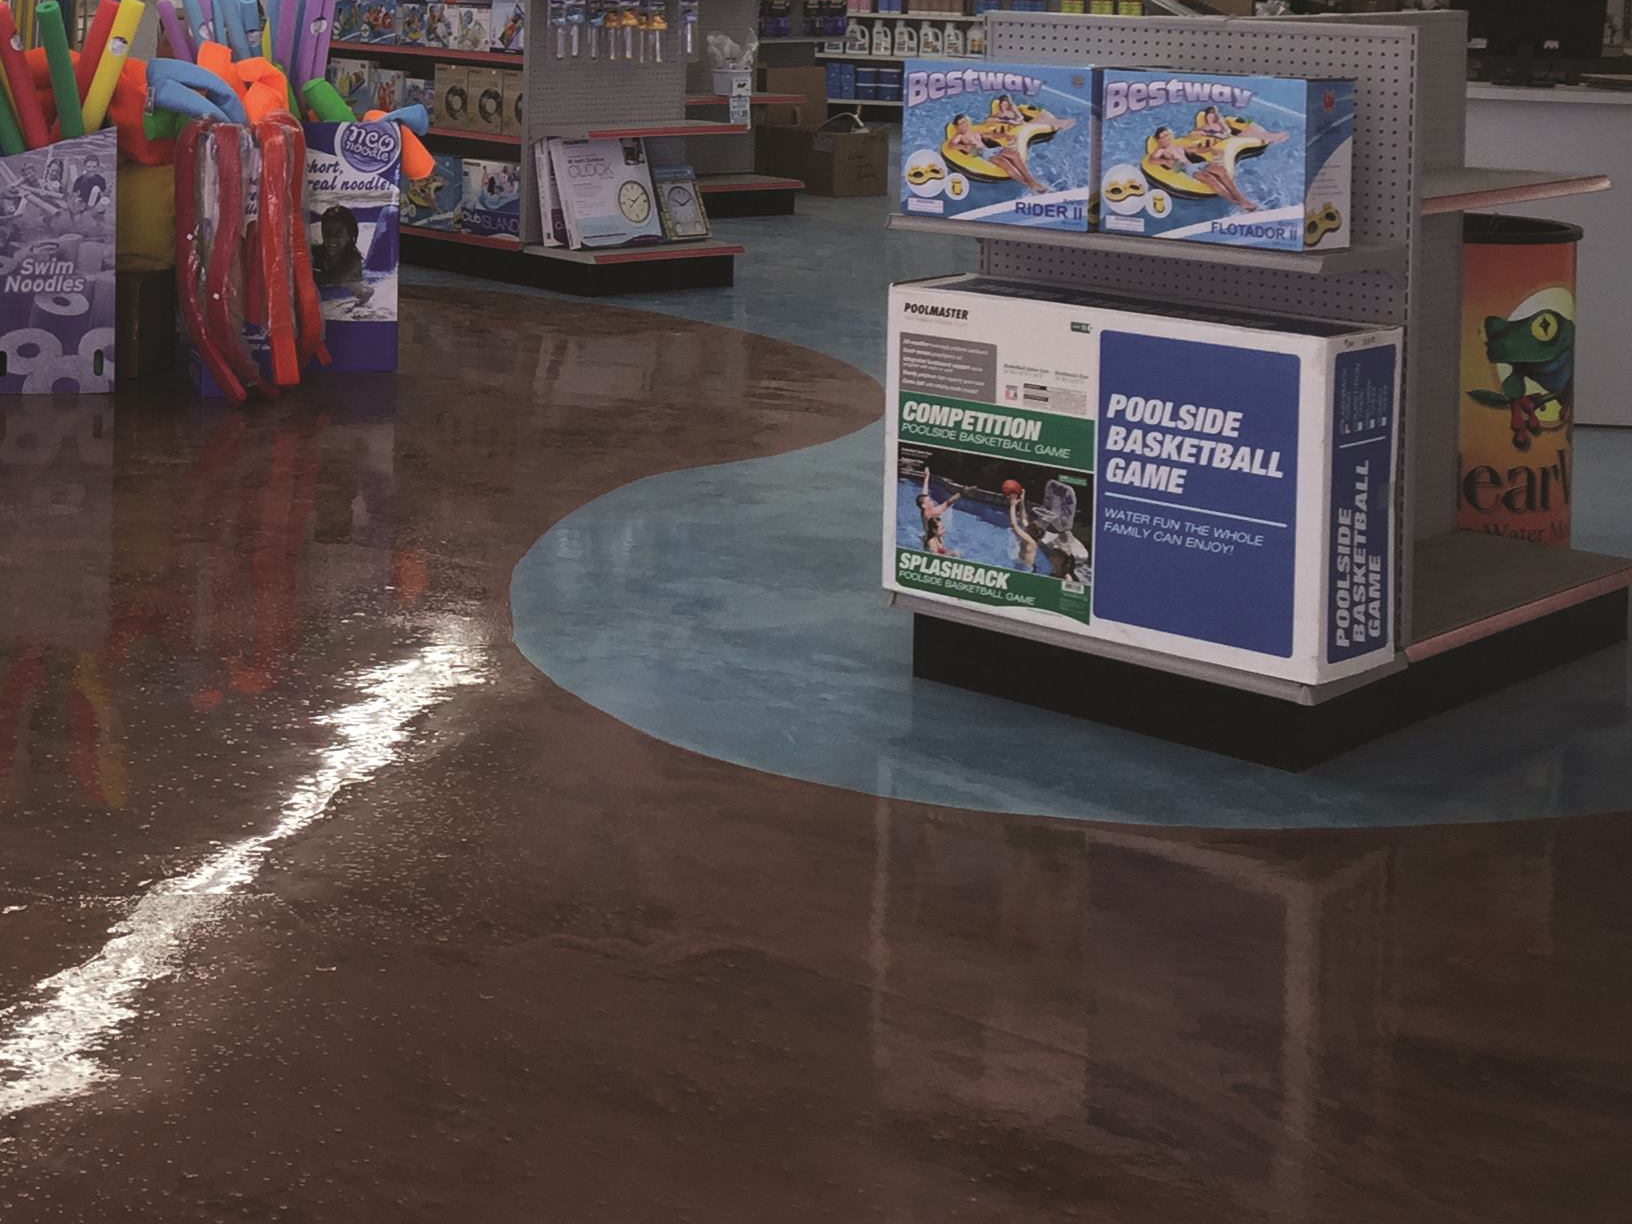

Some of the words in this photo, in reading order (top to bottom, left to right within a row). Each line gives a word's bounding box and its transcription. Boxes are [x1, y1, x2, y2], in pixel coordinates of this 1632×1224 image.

[906, 67, 1042, 109] Bestway
[1104, 78, 1253, 120] Bestway
[345, 141, 390, 162] noodle
[348, 126, 395, 150] neo
[306, 160, 343, 175] hort,
[1015, 201, 1068, 219] RIDER
[1210, 221, 1286, 241] FLOTADOR
[4, 274, 86, 293] Noodles
[19, 257, 74, 275] Swim
[903, 302, 969, 320] POOLMASTER
[902, 400, 1043, 441] COMPETITION
[1106, 393, 1243, 438] POOLSIDE
[901, 423, 957, 441] POOLSIDE
[959, 431, 1032, 453] BASKETBALL
[1034, 444, 1071, 459] GAME
[1105, 425, 1284, 479] BASKETBALL
[1105, 457, 1188, 494] GAME
[1103, 521, 1152, 539] FAMILY
[1153, 530, 1183, 545] CAN
[1185, 536, 1235, 556] ENJOY!
[1104, 507, 1150, 525] WATER
[1153, 516, 1180, 531] FUN
[1184, 521, 1211, 537] THE
[1213, 527, 1265, 547] WHOLE
[1352, 459, 1369, 643] BASKETBALL
[898, 570, 943, 586] POOLSIDE
[945, 577, 1004, 600] BASKETBALL
[1006, 591, 1036, 606] GAME
[899, 552, 1011, 590] SPLASHBACK
[1335, 507, 1352, 649] POOLSIDE
[1368, 554, 1383, 639] GAME
